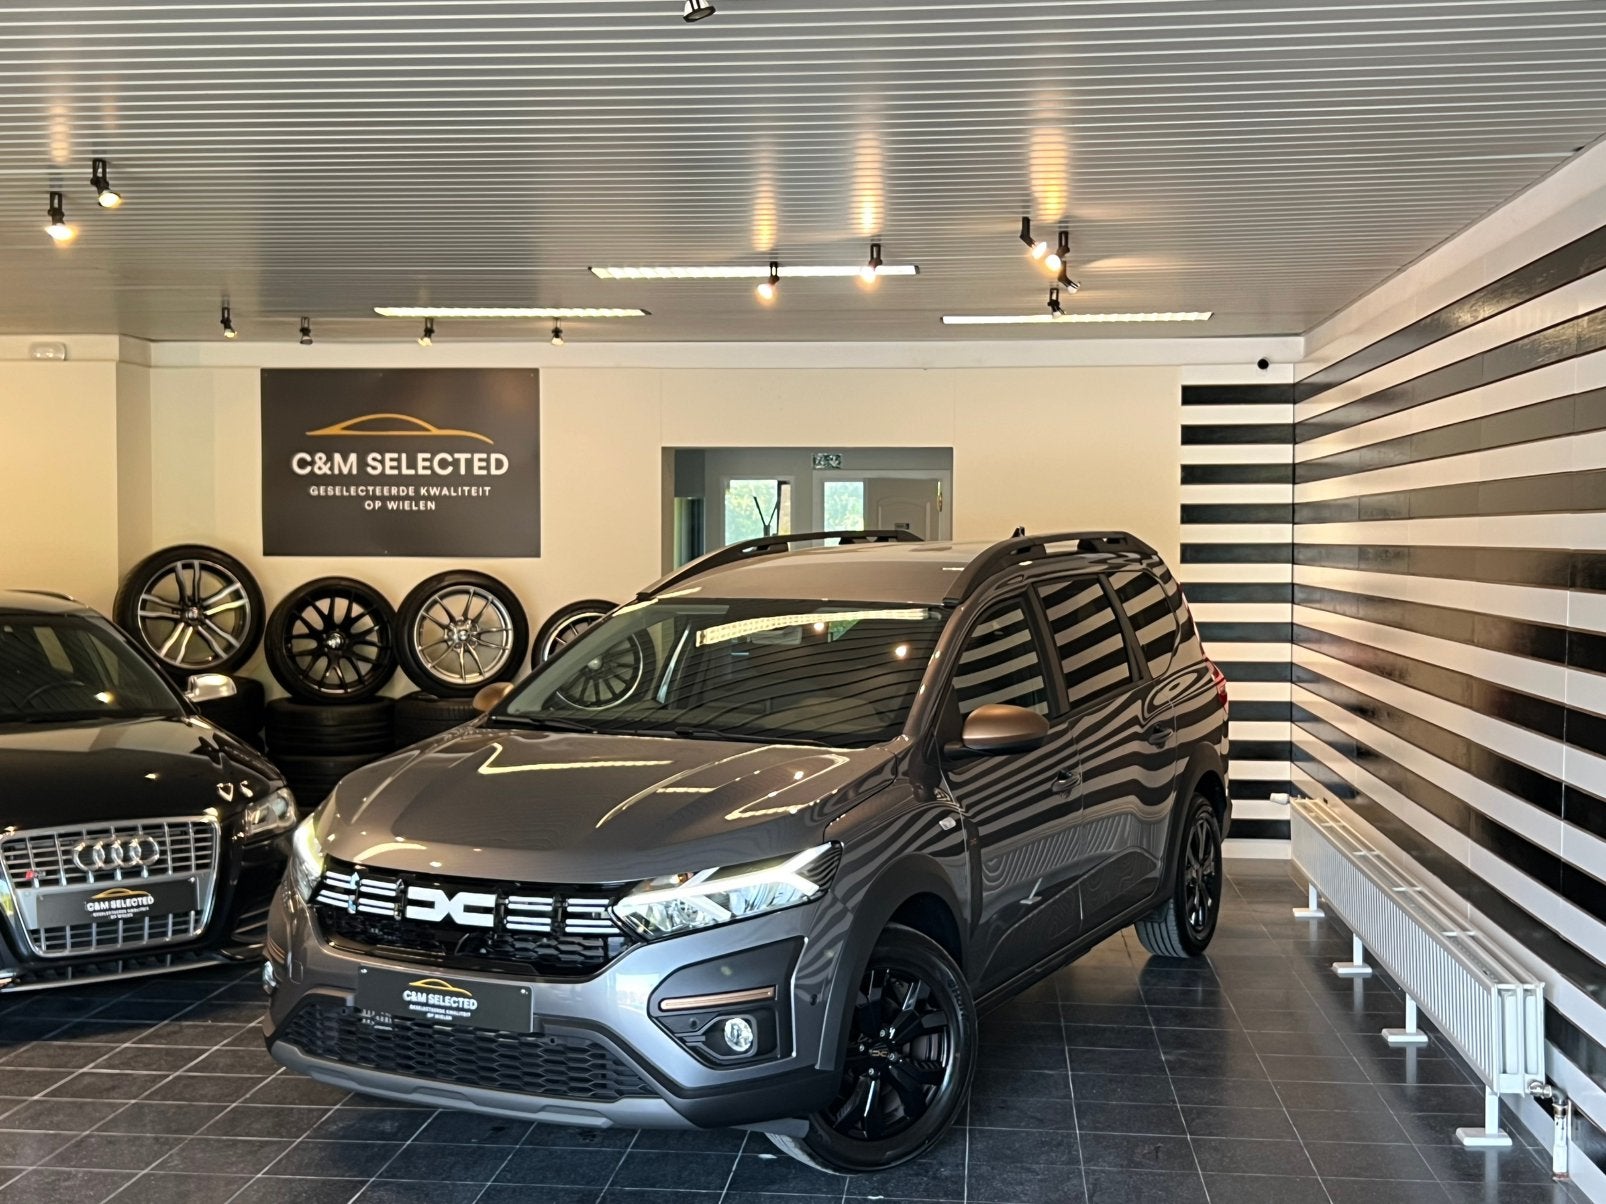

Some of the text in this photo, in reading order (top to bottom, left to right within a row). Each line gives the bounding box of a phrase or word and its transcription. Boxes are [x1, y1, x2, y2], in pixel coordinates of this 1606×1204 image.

[292, 452, 509, 475] C&M SELECTED
[310, 485, 491, 496] GESELECTEERDE KWALITEIT
[364, 500, 436, 510] OP WIELEN
[110, 896, 154, 909] SELECTED
[402, 990, 478, 1010] C&M SELECTED
